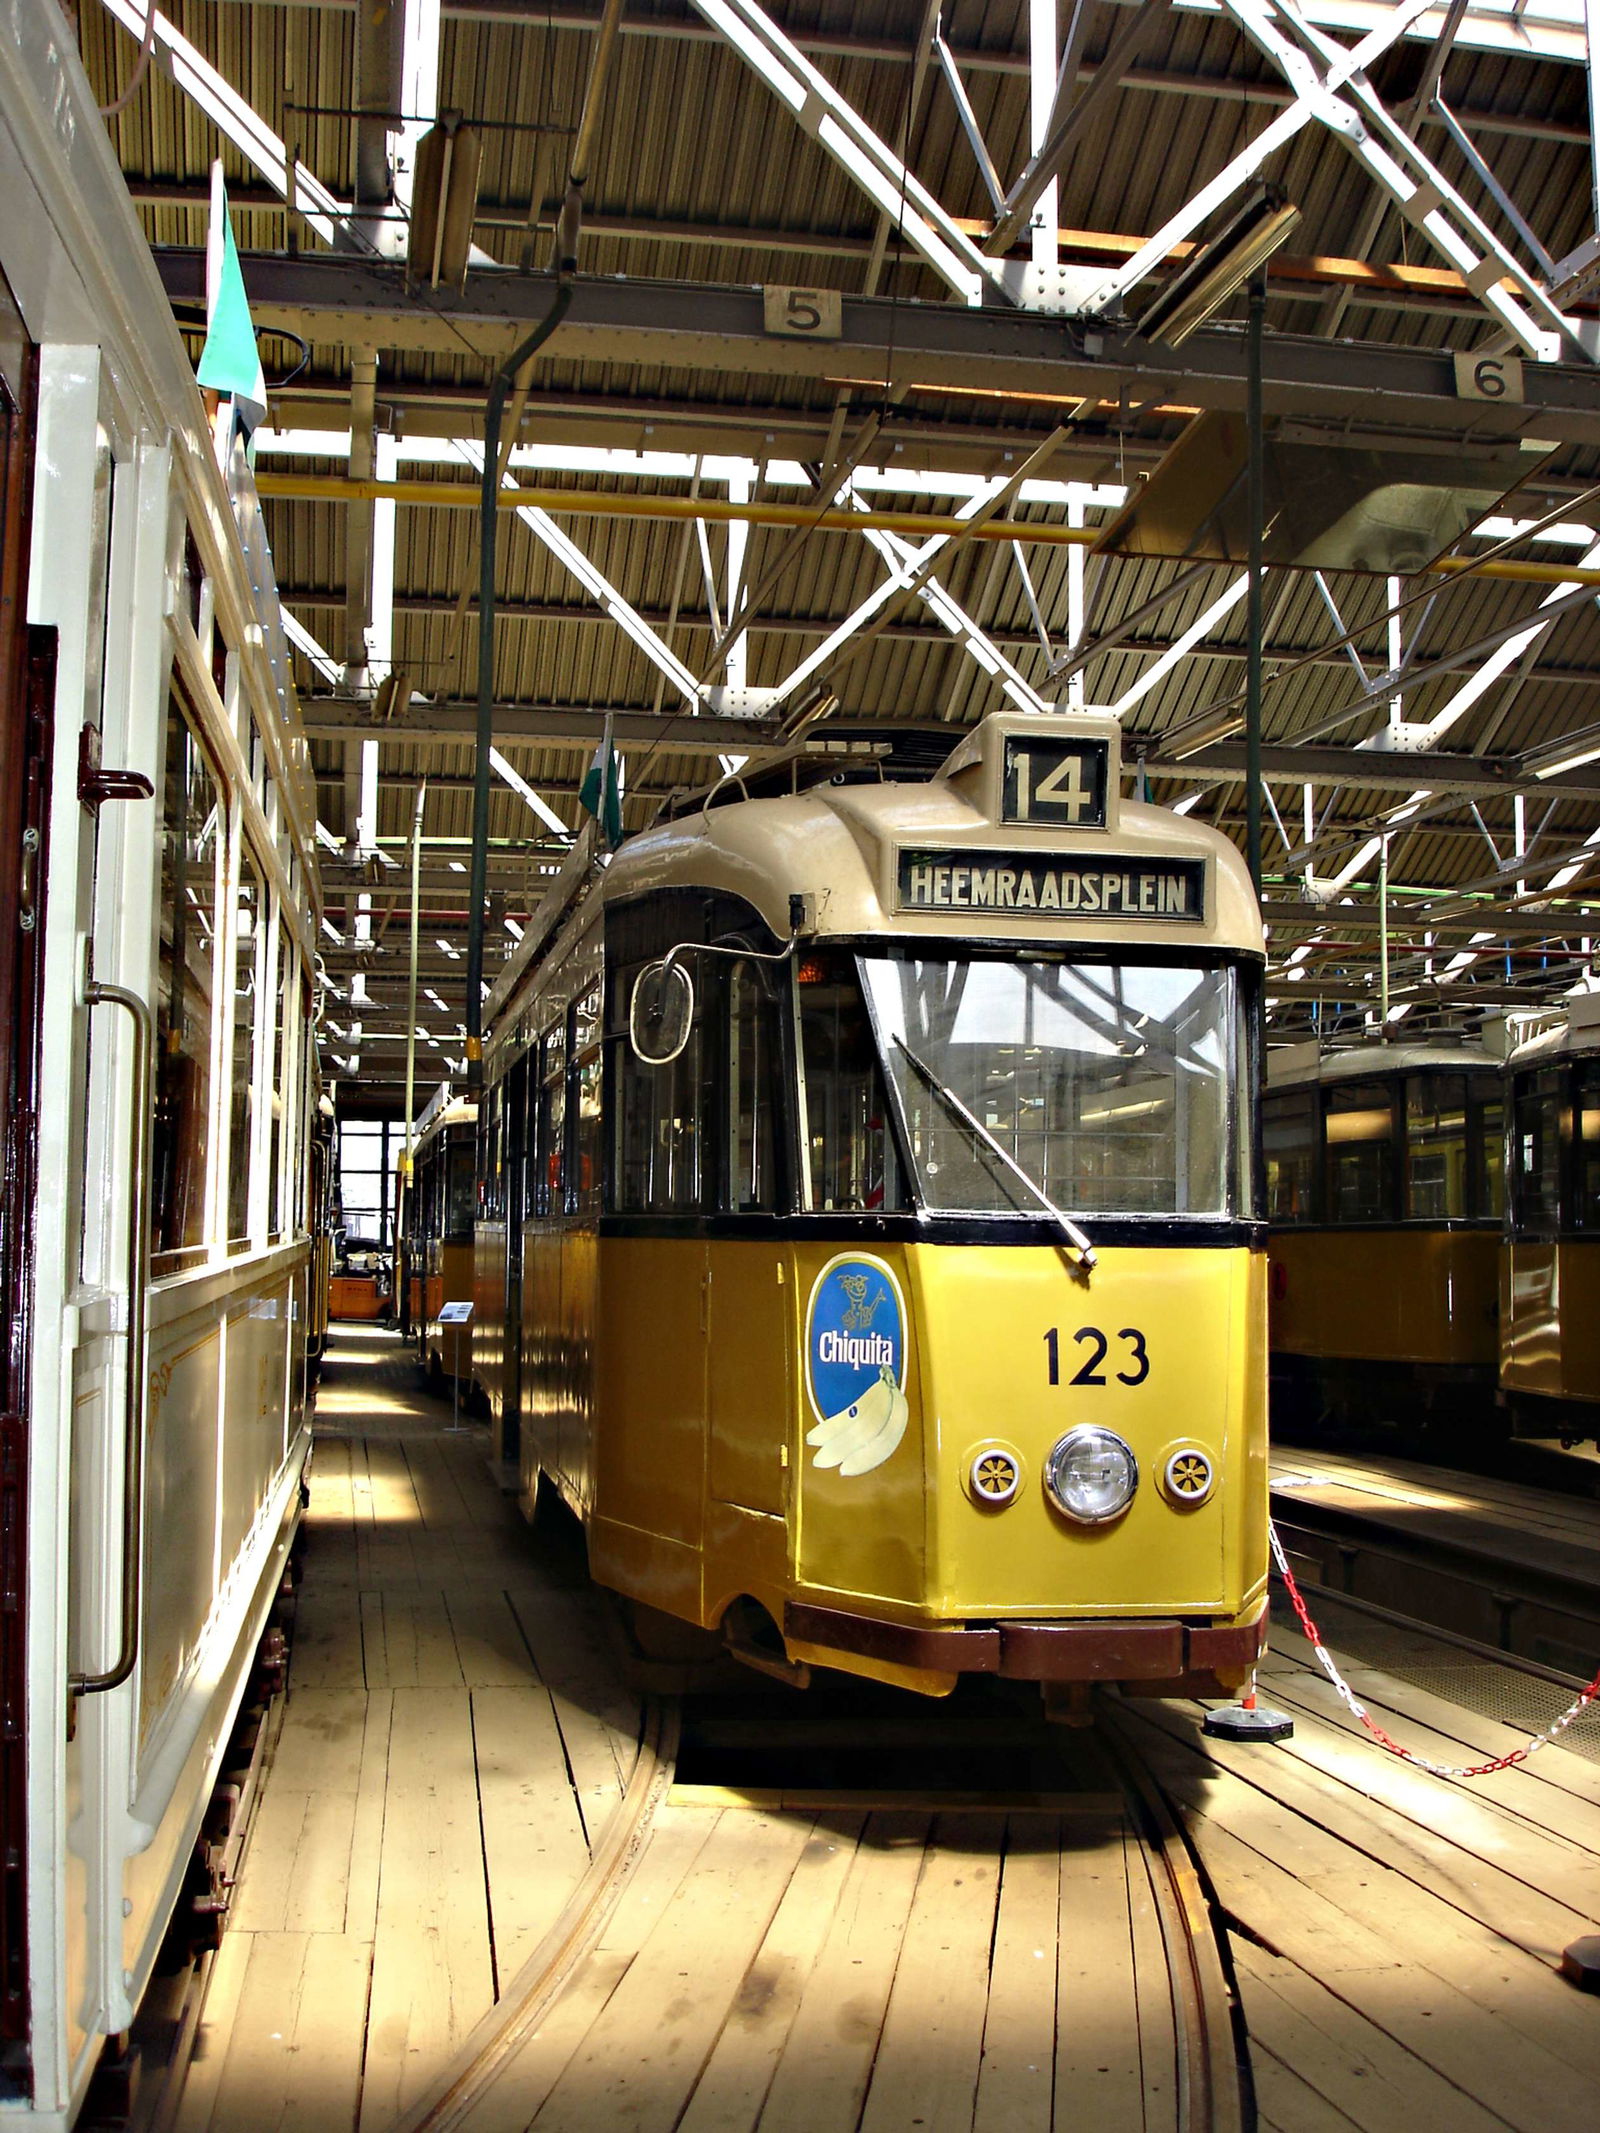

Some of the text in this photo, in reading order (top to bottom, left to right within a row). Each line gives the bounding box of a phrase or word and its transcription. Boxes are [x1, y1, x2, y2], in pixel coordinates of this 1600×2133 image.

[787, 291, 821, 330] 5
[1474, 360, 1505, 397] 6
[1013, 753, 1091, 822] 14
[910, 865, 1186, 913] HEEMRAADSPLEIN
[819, 1330, 893, 1370] Chiquita
[1043, 1327, 1150, 1386] 123
